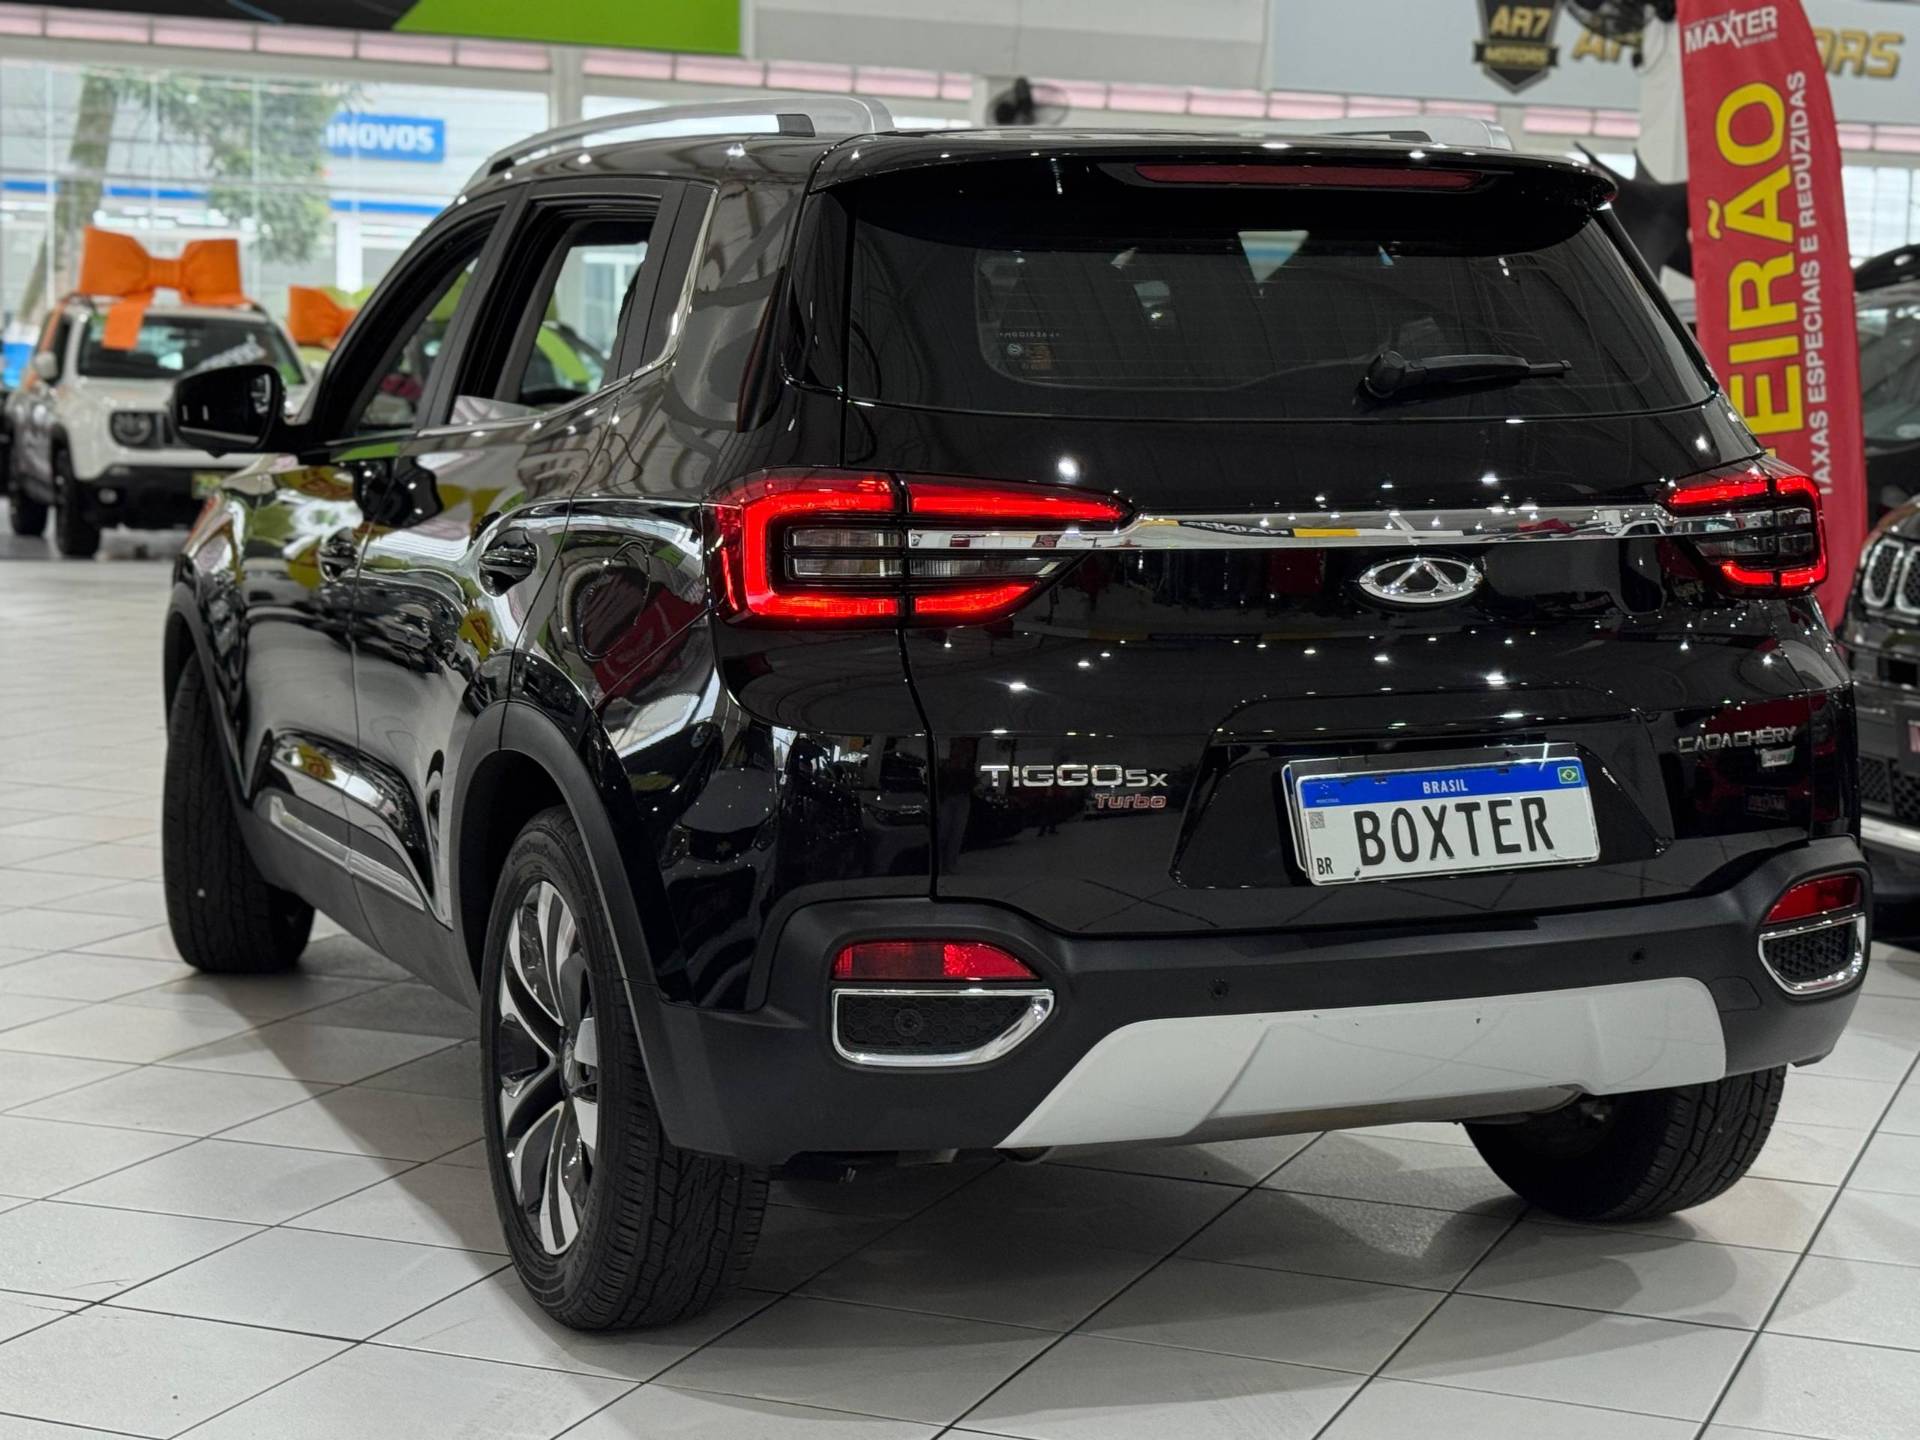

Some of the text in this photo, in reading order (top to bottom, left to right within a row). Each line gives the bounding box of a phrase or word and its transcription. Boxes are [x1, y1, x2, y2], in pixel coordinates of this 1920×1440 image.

[1491, 6, 1551, 38] AR7
[1684, 6, 1778, 54] MAXTER
[1786, 70, 1817, 228] REDUZIDAS
[1800, 233, 1819, 253] E
[1707, 78, 1804, 458] EIRÃO
[1800, 259, 1828, 404] ESPECIAIS
[1733, 725, 1798, 748] CHERY
[1094, 793, 1167, 809] Turbo
[1422, 779, 1469, 795] BRASIL
[1353, 796, 1554, 867] BOXTER
[1316, 857, 1334, 876] BR
